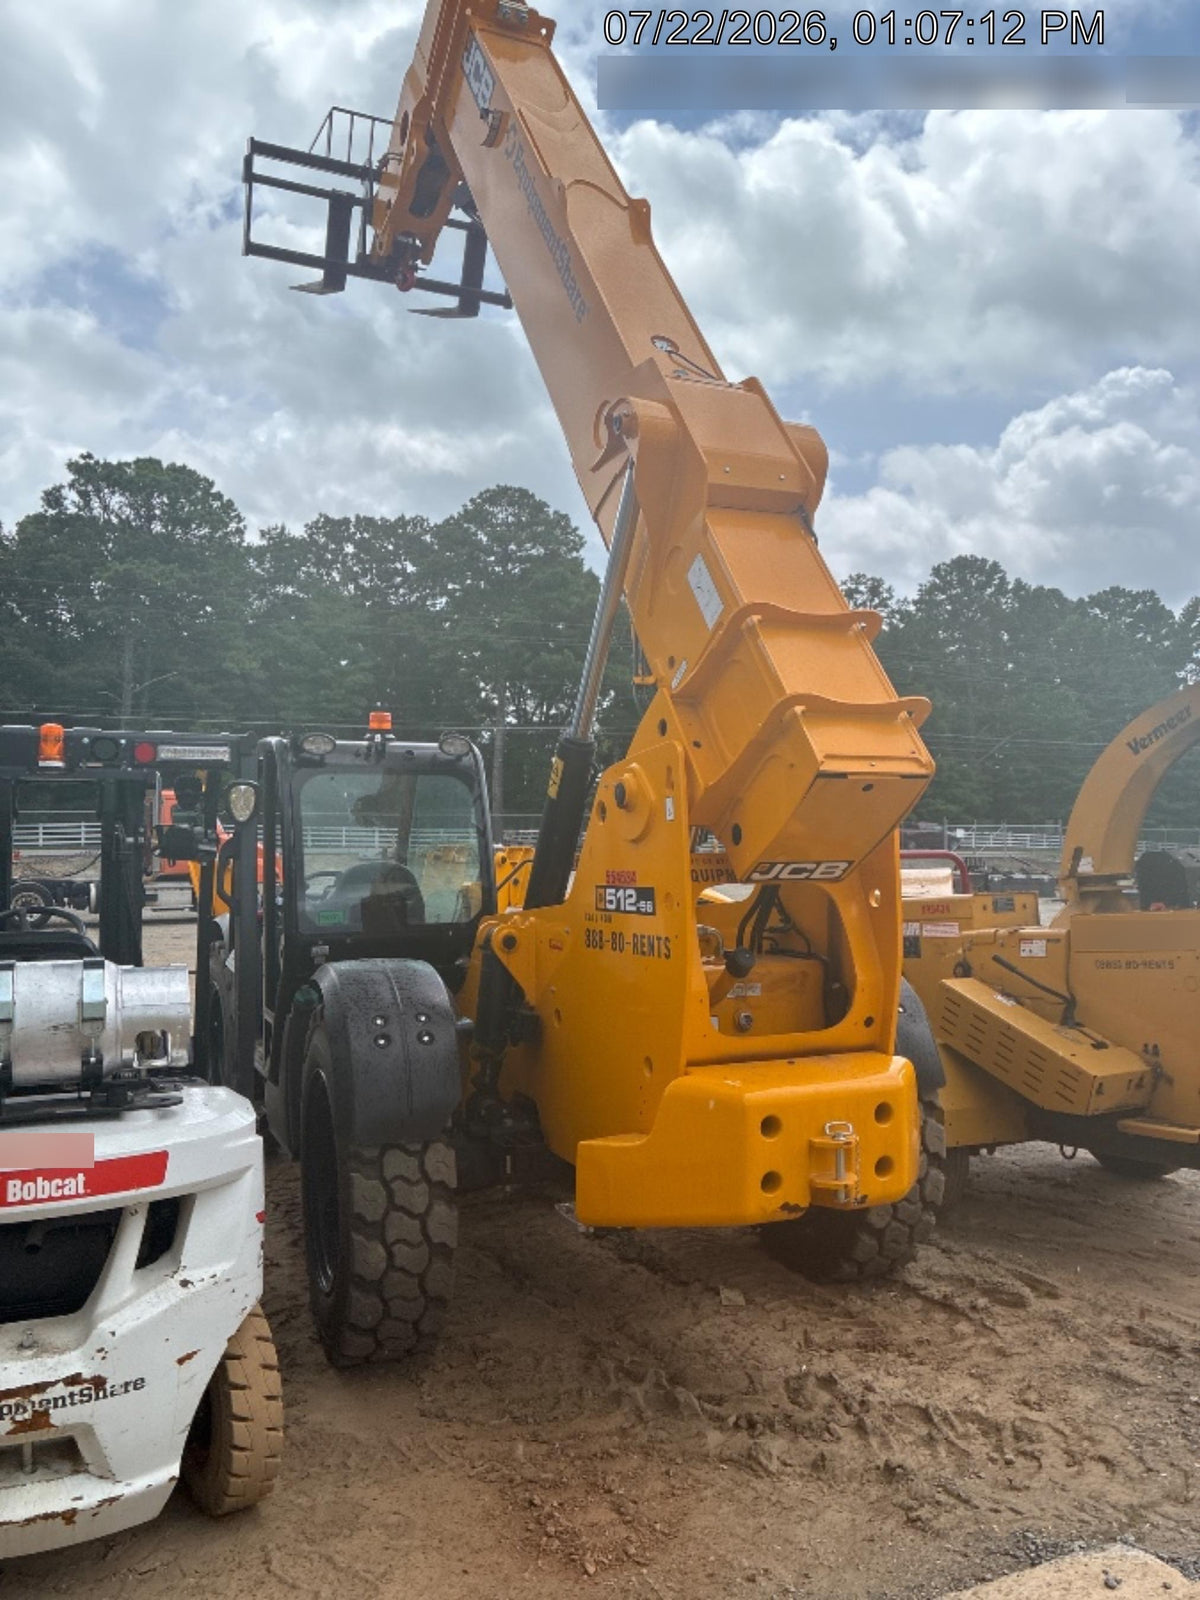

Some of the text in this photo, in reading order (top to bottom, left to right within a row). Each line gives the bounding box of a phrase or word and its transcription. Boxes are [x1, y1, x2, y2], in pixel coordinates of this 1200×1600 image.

[462, 38, 495, 109] JCB
[1126, 704, 1192, 757] Vermeer
[750, 861, 850, 880] JCB
[585, 927, 671, 960] 888-80-RENTS
[6, 1172, 86, 1203] Bobcat
